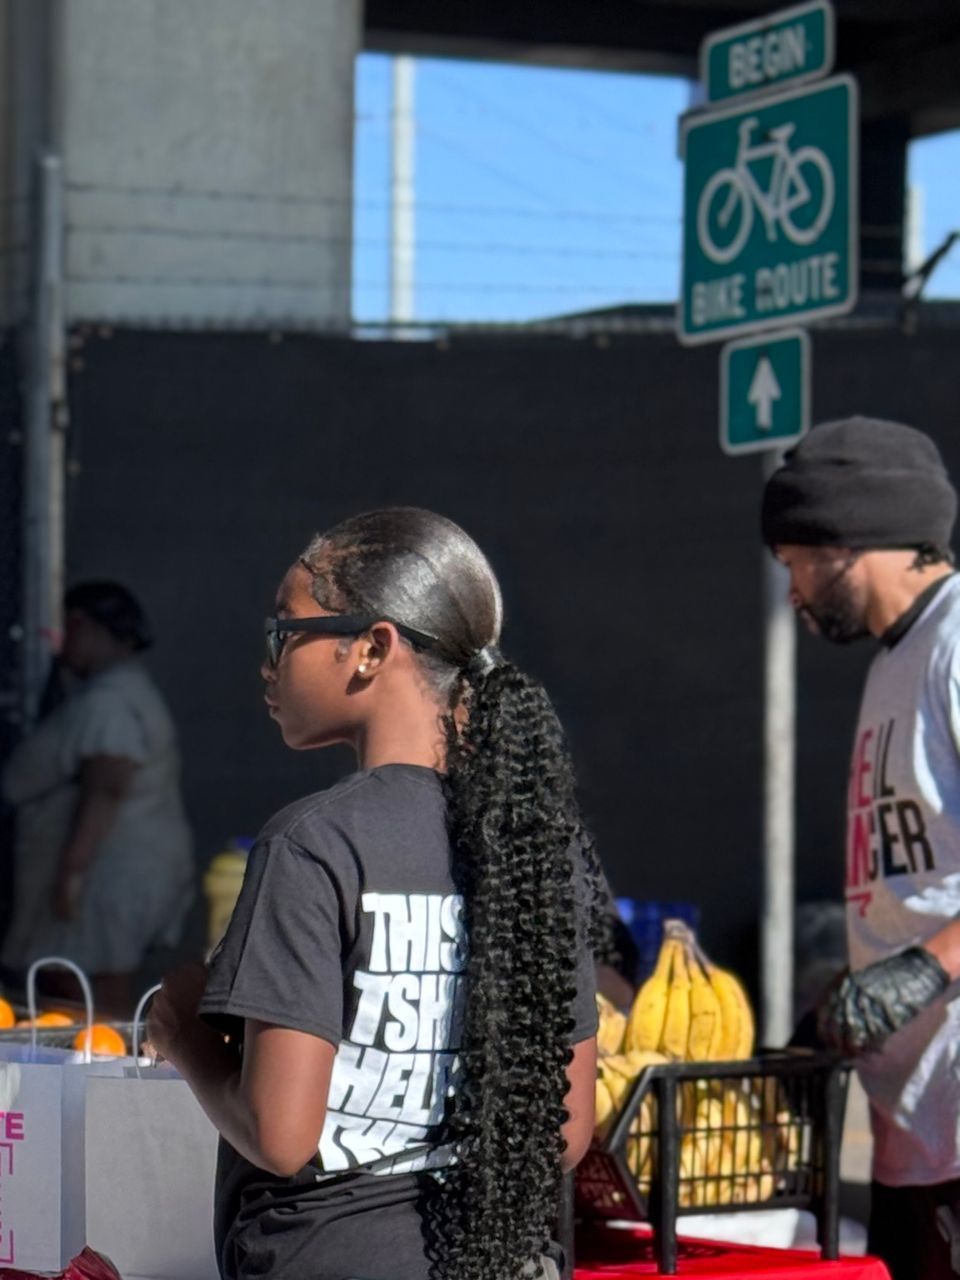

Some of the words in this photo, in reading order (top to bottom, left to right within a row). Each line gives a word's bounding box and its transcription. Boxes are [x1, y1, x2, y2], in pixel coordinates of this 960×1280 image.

[727, 23, 807, 90] BEGIN
[691, 275, 747, 326] BIKE
[754, 252, 840, 312] ROUTE
[361, 892, 470, 973] THIS
